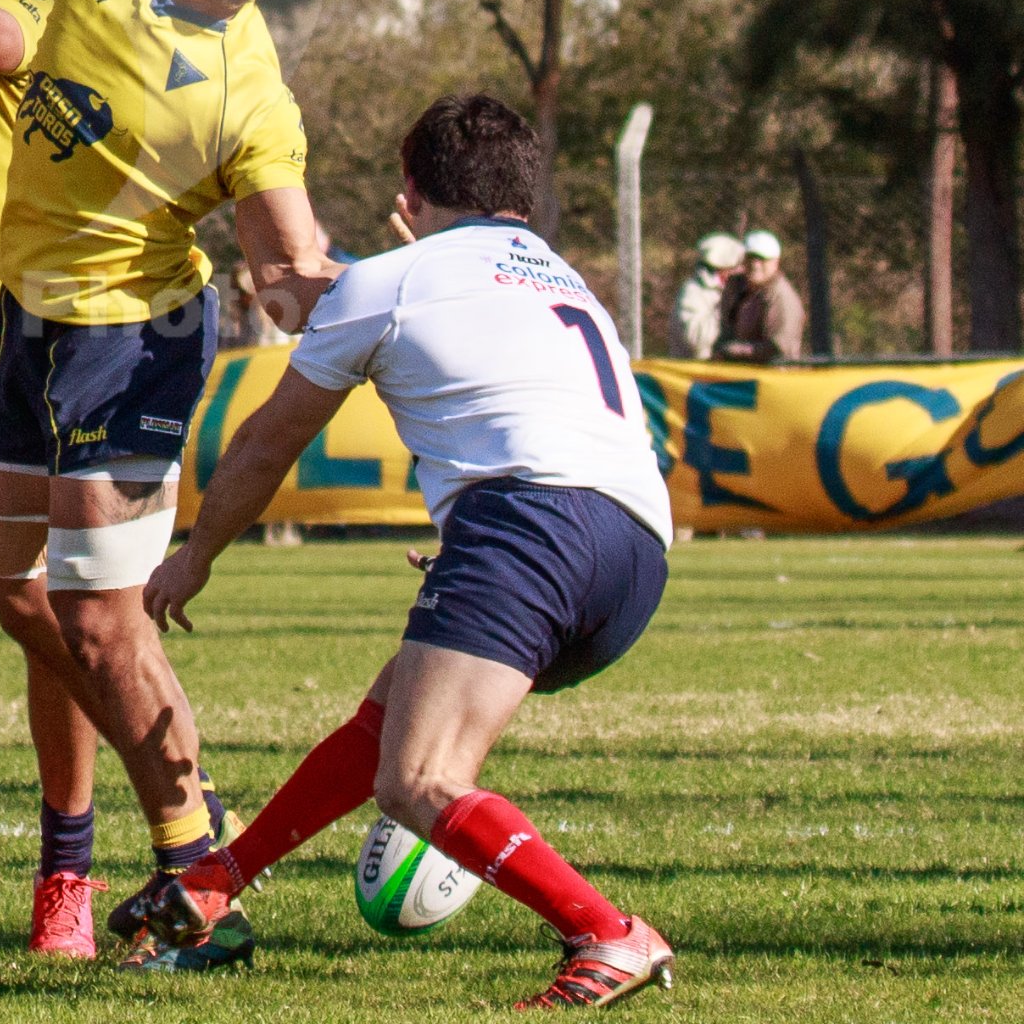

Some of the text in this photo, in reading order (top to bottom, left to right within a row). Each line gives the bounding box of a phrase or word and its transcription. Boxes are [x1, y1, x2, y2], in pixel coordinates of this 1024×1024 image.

[32, 95, 74, 147] TOROS
[549, 302, 625, 419] 1
[69, 424, 108, 446] flash
